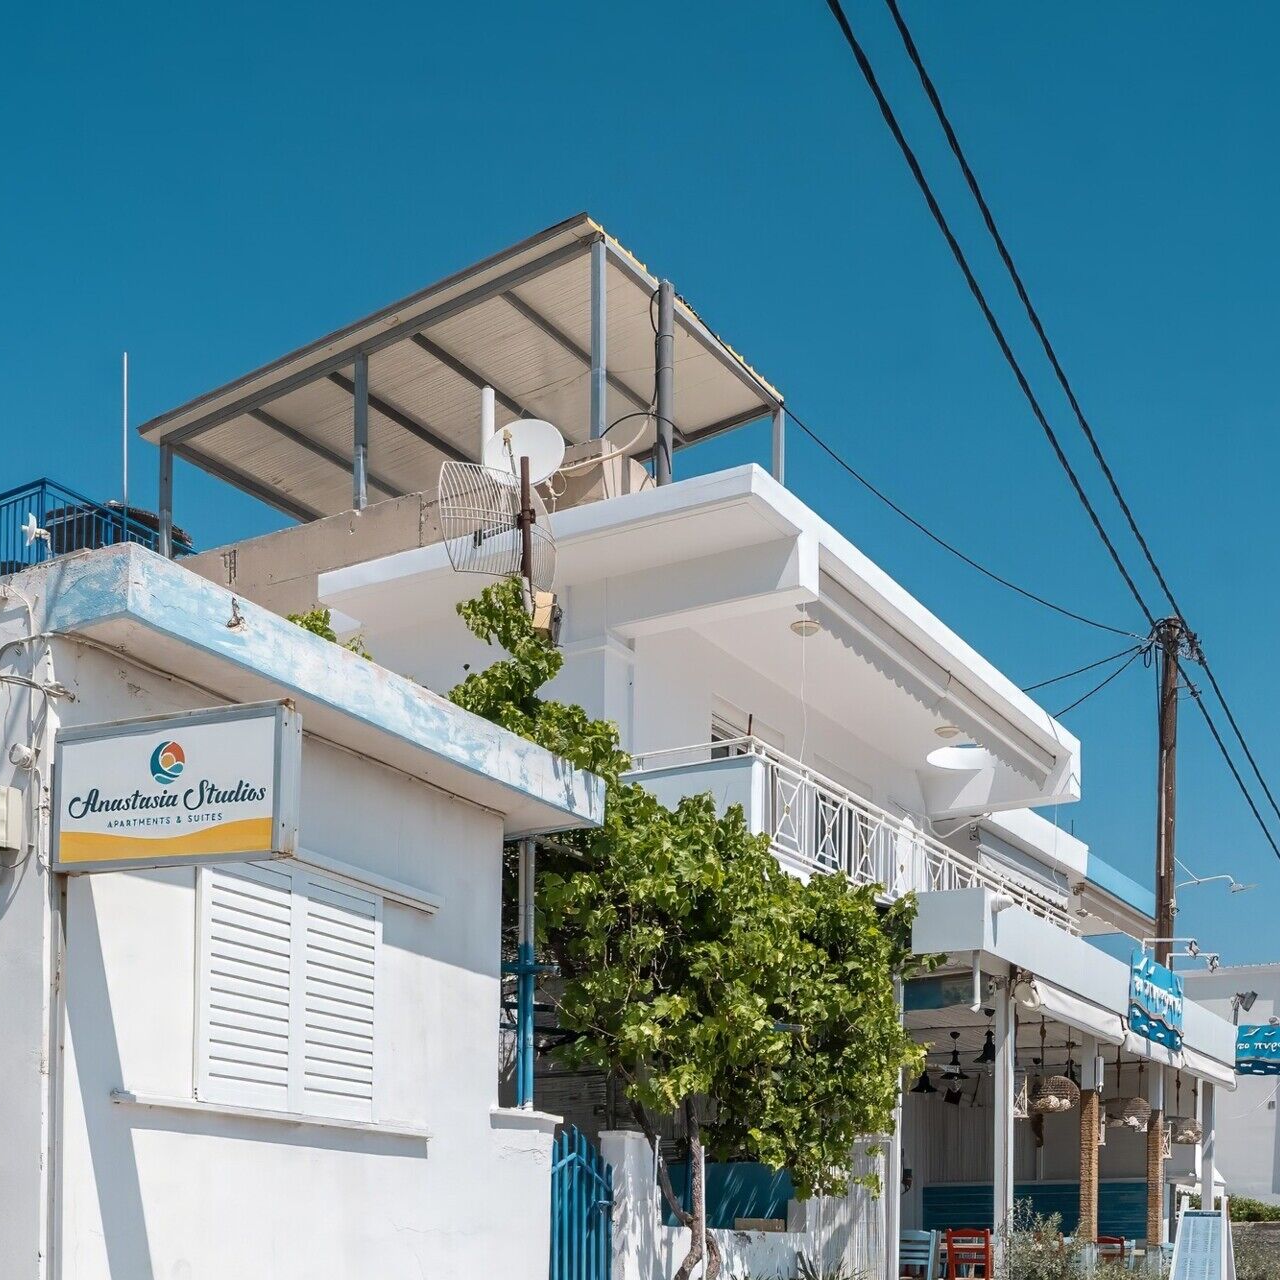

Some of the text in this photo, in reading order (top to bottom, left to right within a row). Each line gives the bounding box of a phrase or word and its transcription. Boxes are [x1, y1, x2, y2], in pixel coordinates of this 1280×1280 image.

[68, 780, 266, 819] Anastasia Studios
[107, 812, 223, 828] APARTMENTS & SUITES
